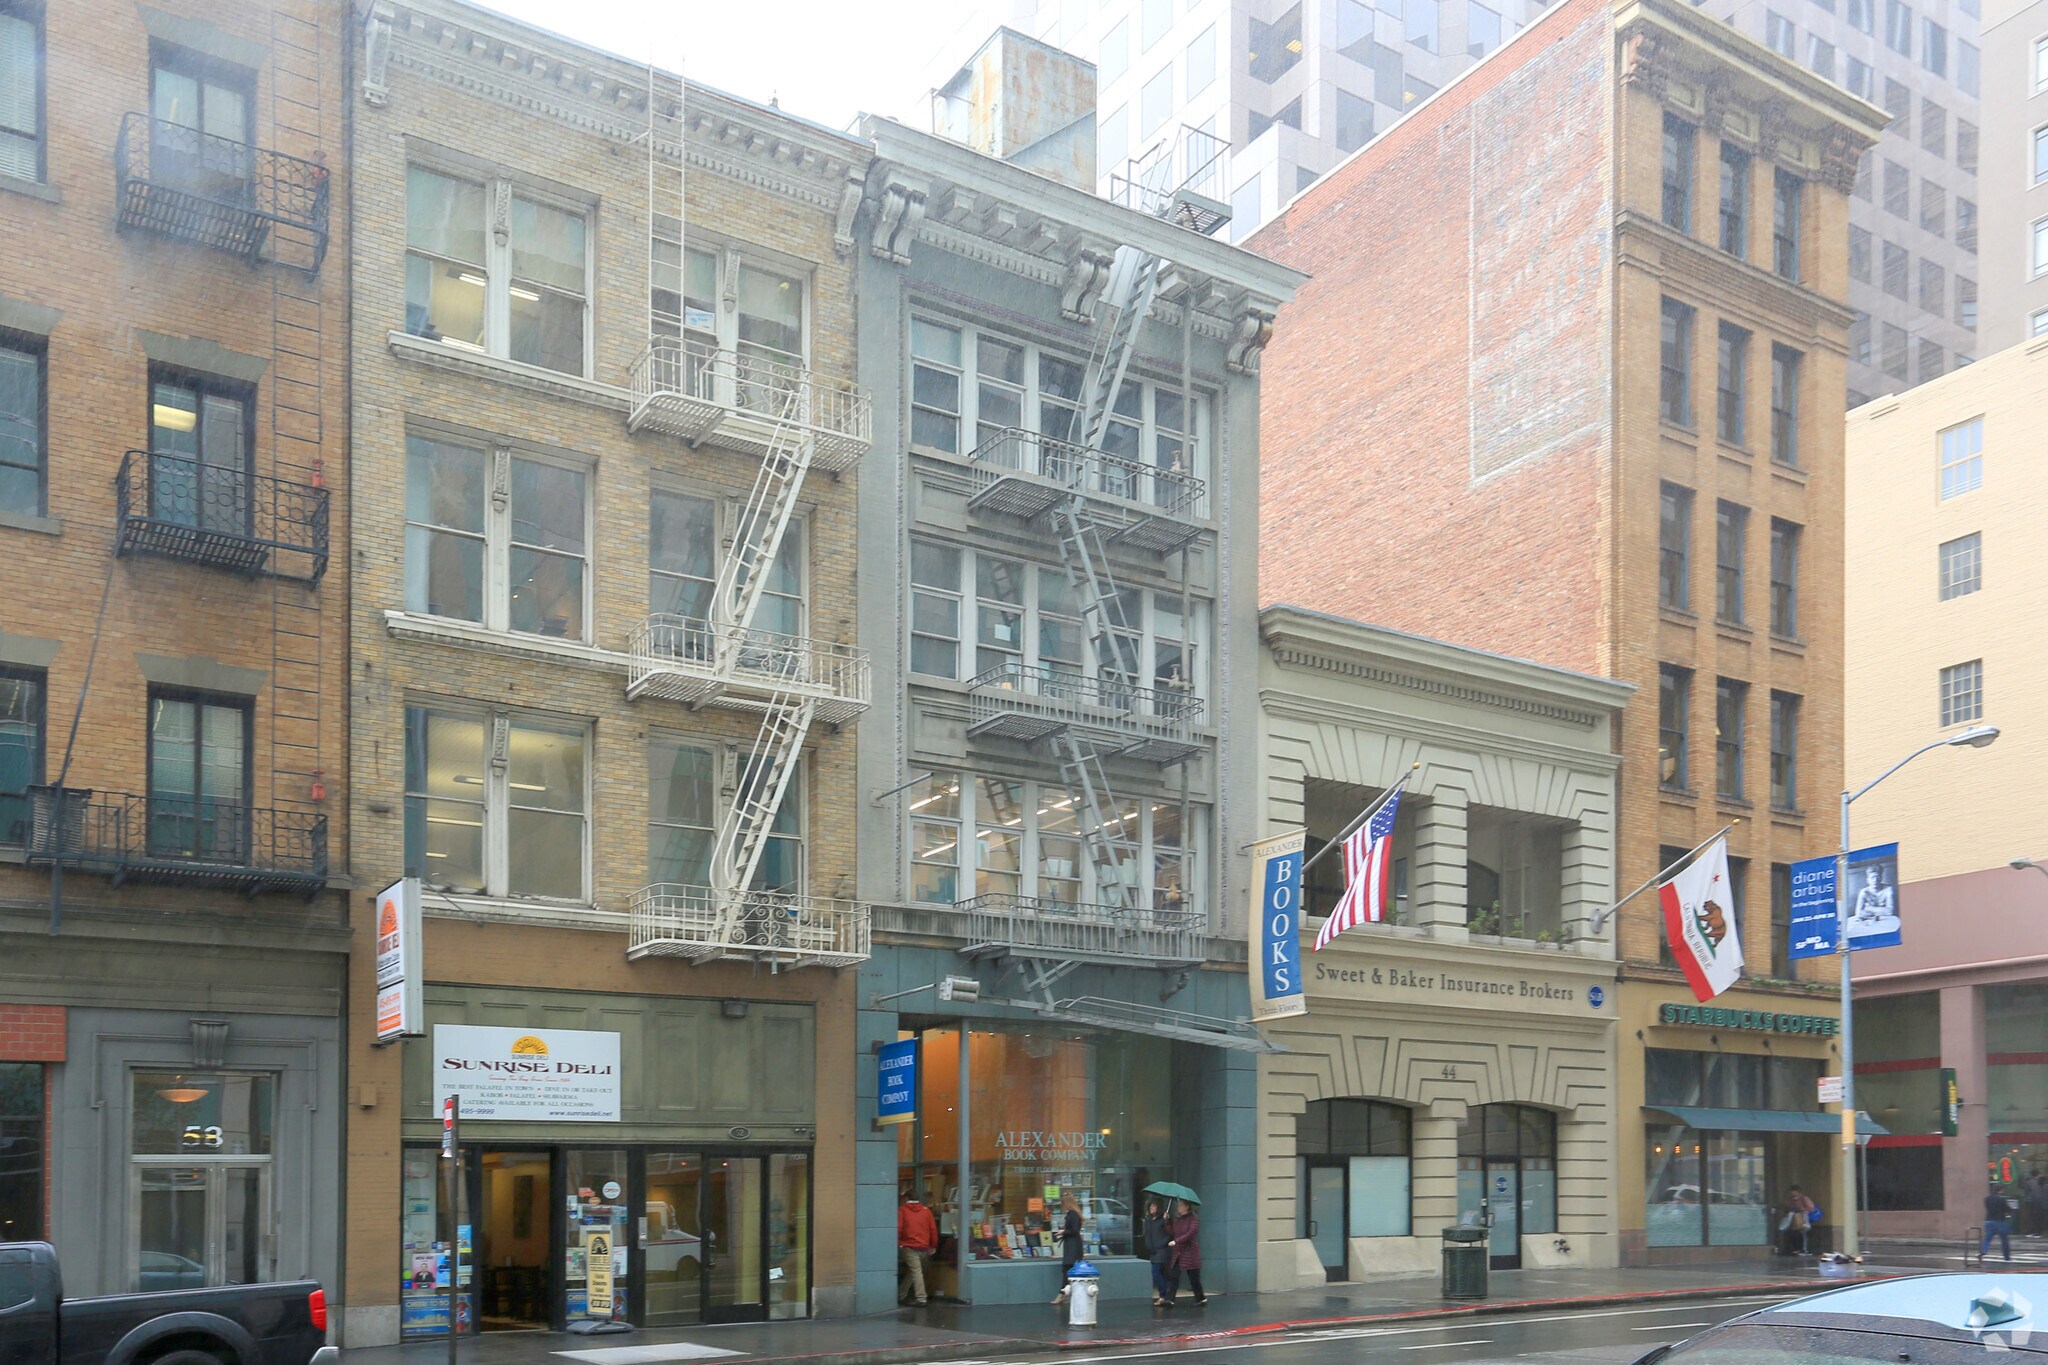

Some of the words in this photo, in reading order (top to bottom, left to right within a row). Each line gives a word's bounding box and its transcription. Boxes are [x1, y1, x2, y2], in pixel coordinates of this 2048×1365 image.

[1254, 838, 1303, 859] ALEXANDER
[1792, 869, 1835, 885] diane
[1792, 883, 1834, 898] arbus
[1271, 859, 1292, 992] BOOKS
[1315, 962, 1366, 983] Sweet
[1371, 967, 1383, 985] &
[1389, 968, 1434, 989] Baker
[1440, 974, 1515, 996] Insurance
[1519, 980, 1574, 1000] Brokers
[1661, 1002, 1775, 1031] STARBUCKS
[1775, 1013, 1841, 1035] COFFEE
[443, 1057, 550, 1074] SUNRISE
[556, 1062, 613, 1075] DELI
[1441, 1064, 1456, 1079] 44
[995, 1131, 1107, 1148] ALEXANDER
[1004, 1149, 1037, 1160] BOOK
[1040, 1149, 1099, 1161] COMPANY
